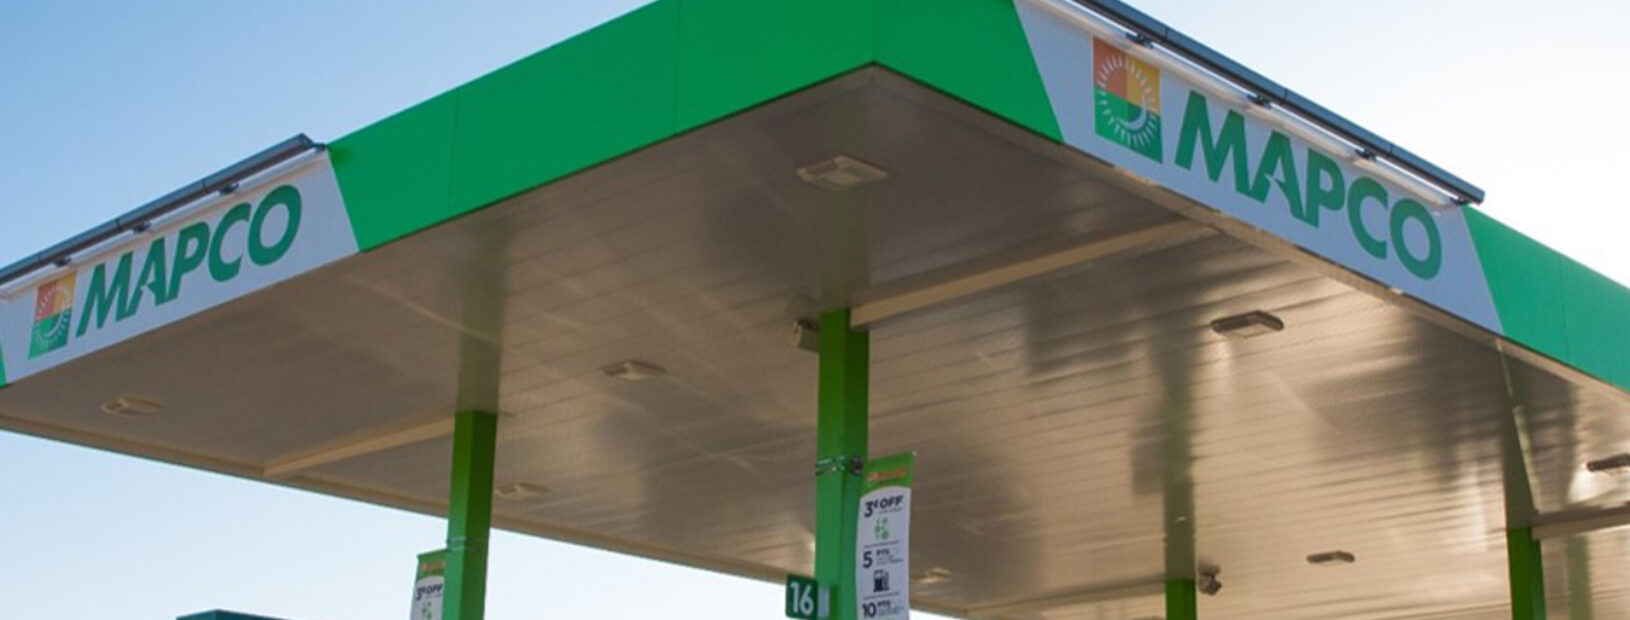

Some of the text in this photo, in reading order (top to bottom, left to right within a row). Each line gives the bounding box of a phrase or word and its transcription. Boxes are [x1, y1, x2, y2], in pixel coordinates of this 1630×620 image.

[1174, 89, 1442, 281] MAPCO
[75, 184, 303, 338] MAPCO
[880, 495, 904, 509] OFF
[863, 550, 873, 569] 5
[790, 581, 815, 615] 16
[862, 602, 877, 619] 10
